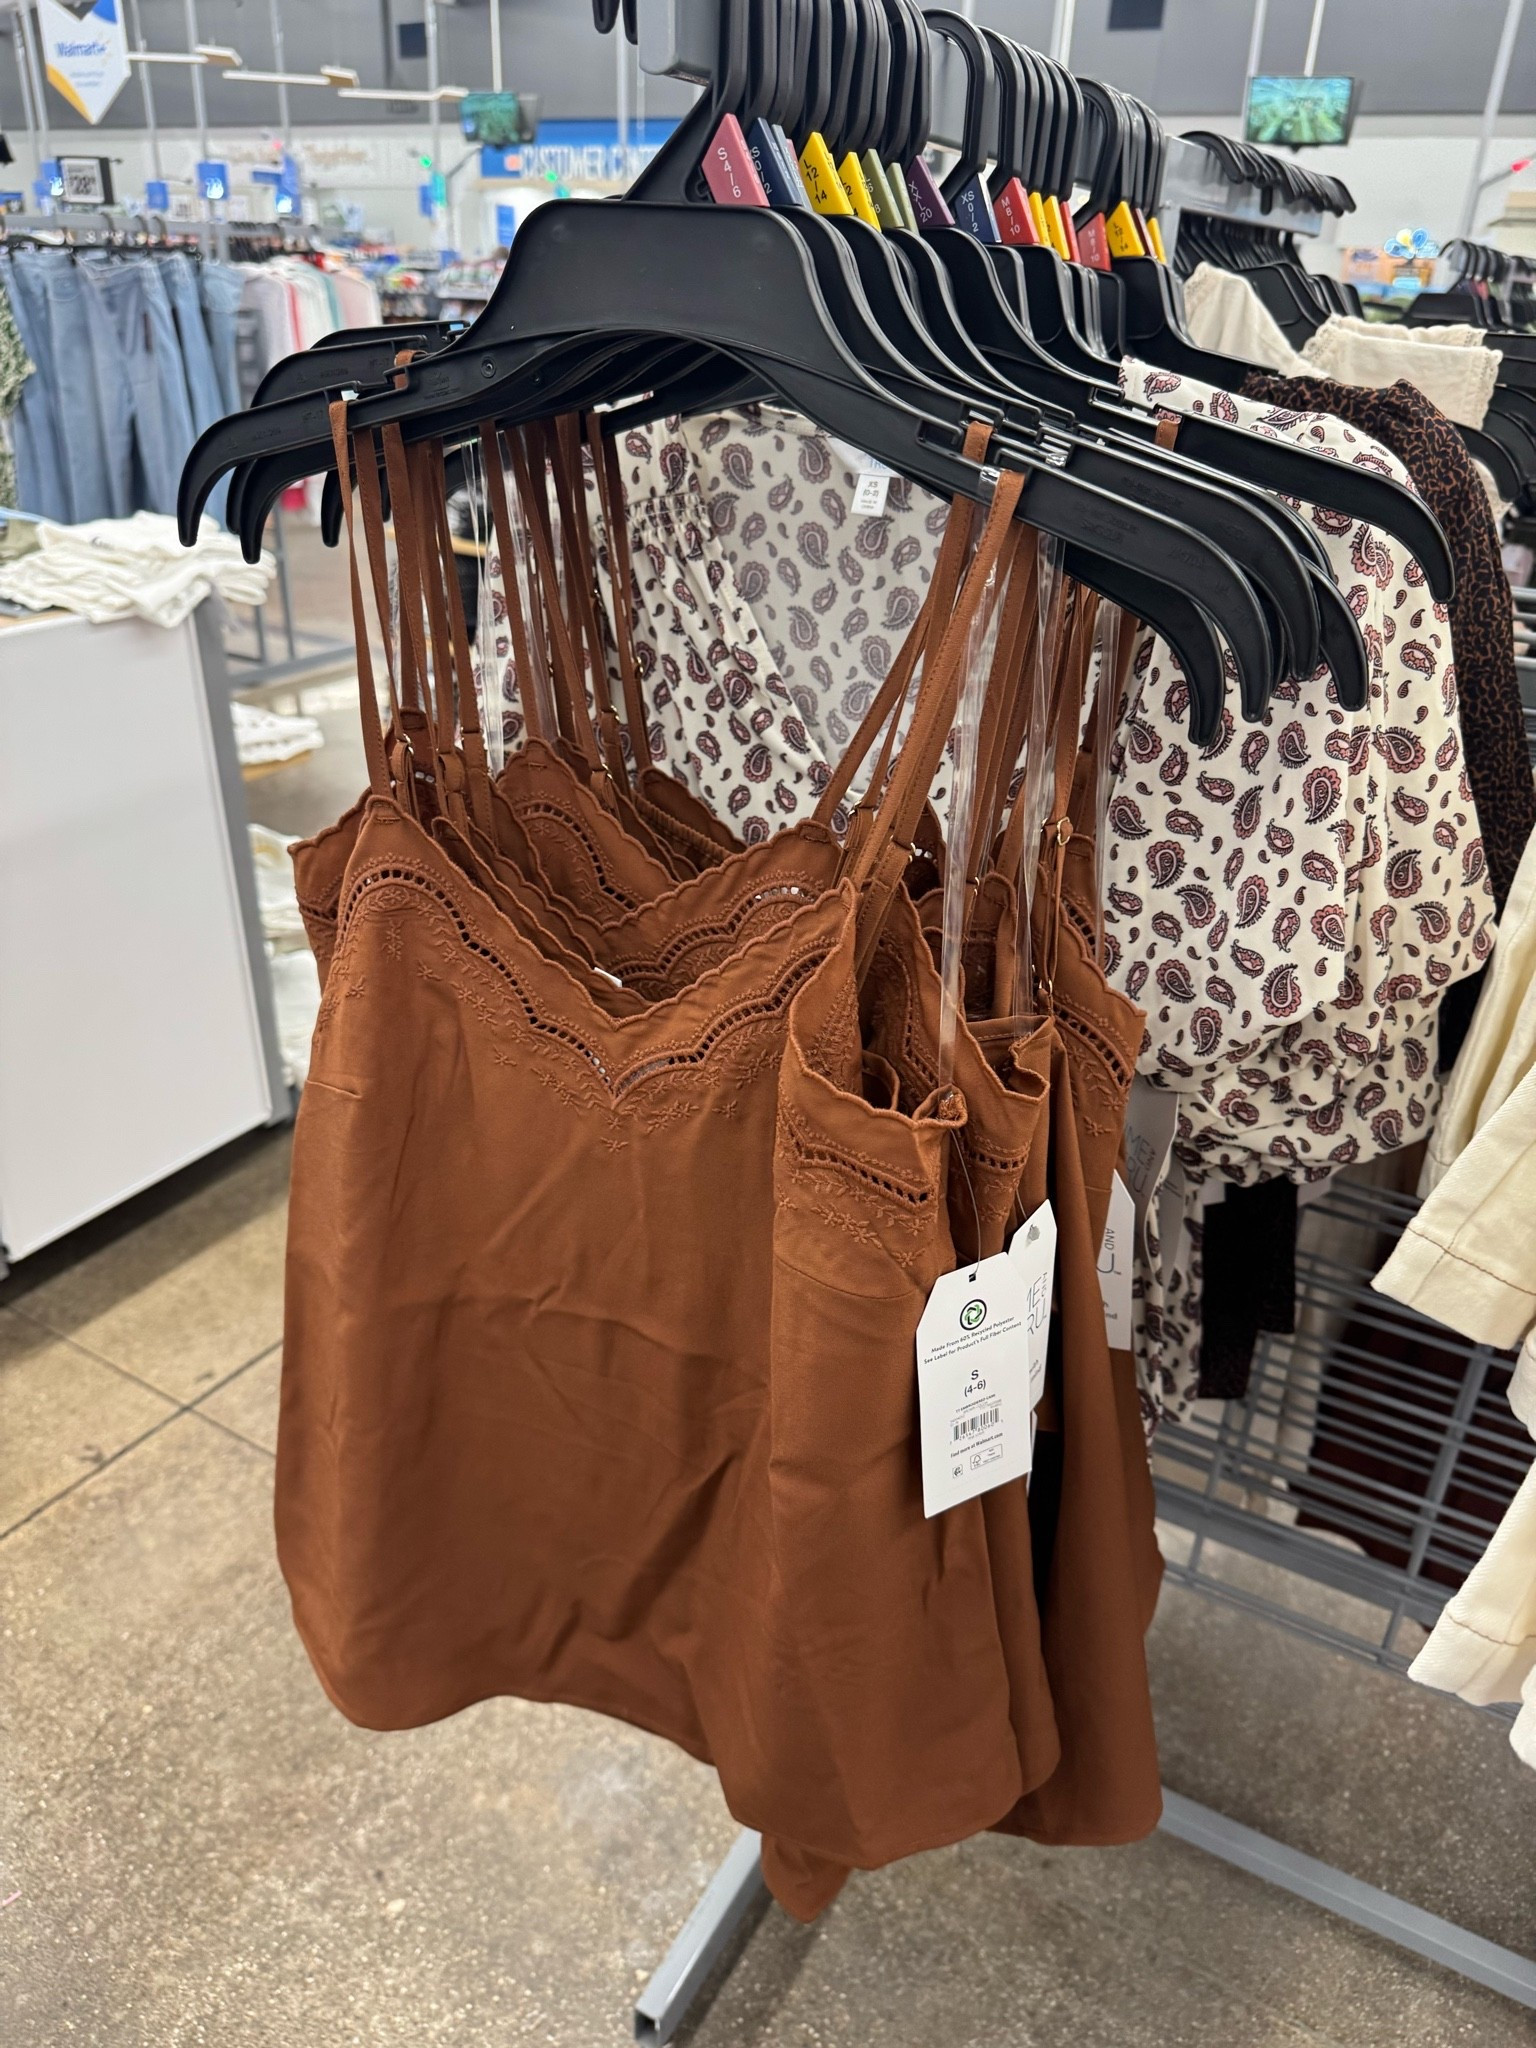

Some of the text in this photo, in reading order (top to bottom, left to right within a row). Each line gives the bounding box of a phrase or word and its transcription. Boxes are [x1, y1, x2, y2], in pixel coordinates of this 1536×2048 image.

[520, 145, 606, 179] CUSTOMER
[930, 1344, 946, 1353] Made
[946, 1339, 960, 1348] From
[971, 1324, 992, 1338] Recycled
[992, 1316, 1014, 1328] Polyester
[934, 1352, 948, 1361] Label
[980, 1334, 989, 1342] Full
[990, 1330, 1002, 1338] Fiber
[1002, 1321, 1022, 1333] Content
[964, 1379, 986, 1398] (4-6)
[971, 1370, 979, 1380] S
